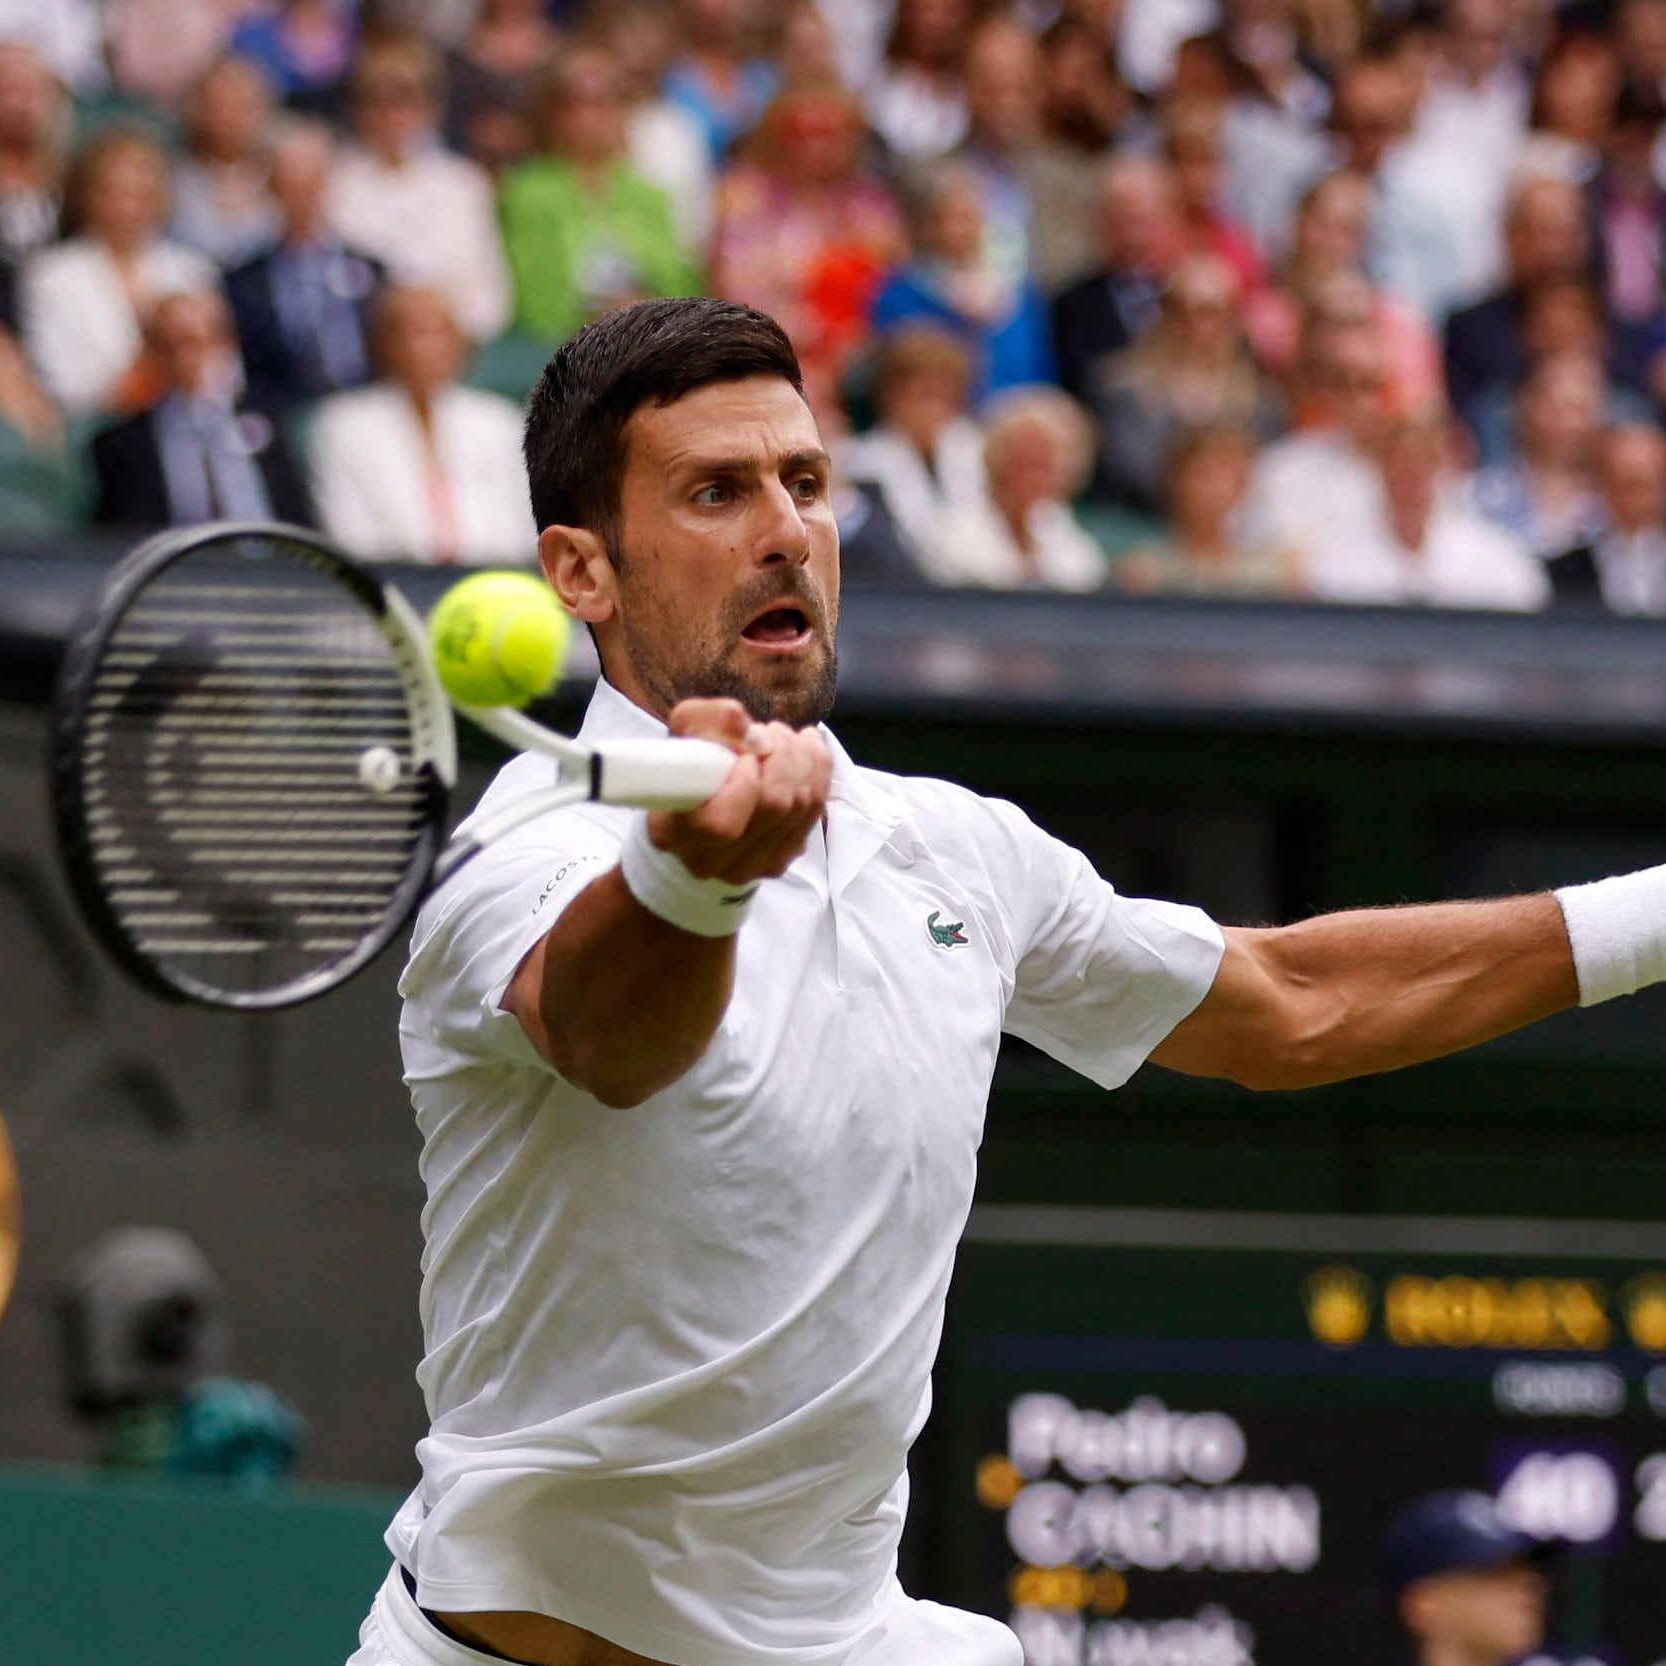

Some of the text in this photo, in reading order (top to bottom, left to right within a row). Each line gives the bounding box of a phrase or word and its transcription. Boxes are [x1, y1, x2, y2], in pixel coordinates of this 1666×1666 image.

[531, 855, 602, 916] LACOST
[1386, 1275, 1612, 1351] ROLEX
[1009, 1393, 1246, 1484] Pedro
[1008, 1481, 1321, 1574] CACHIN
